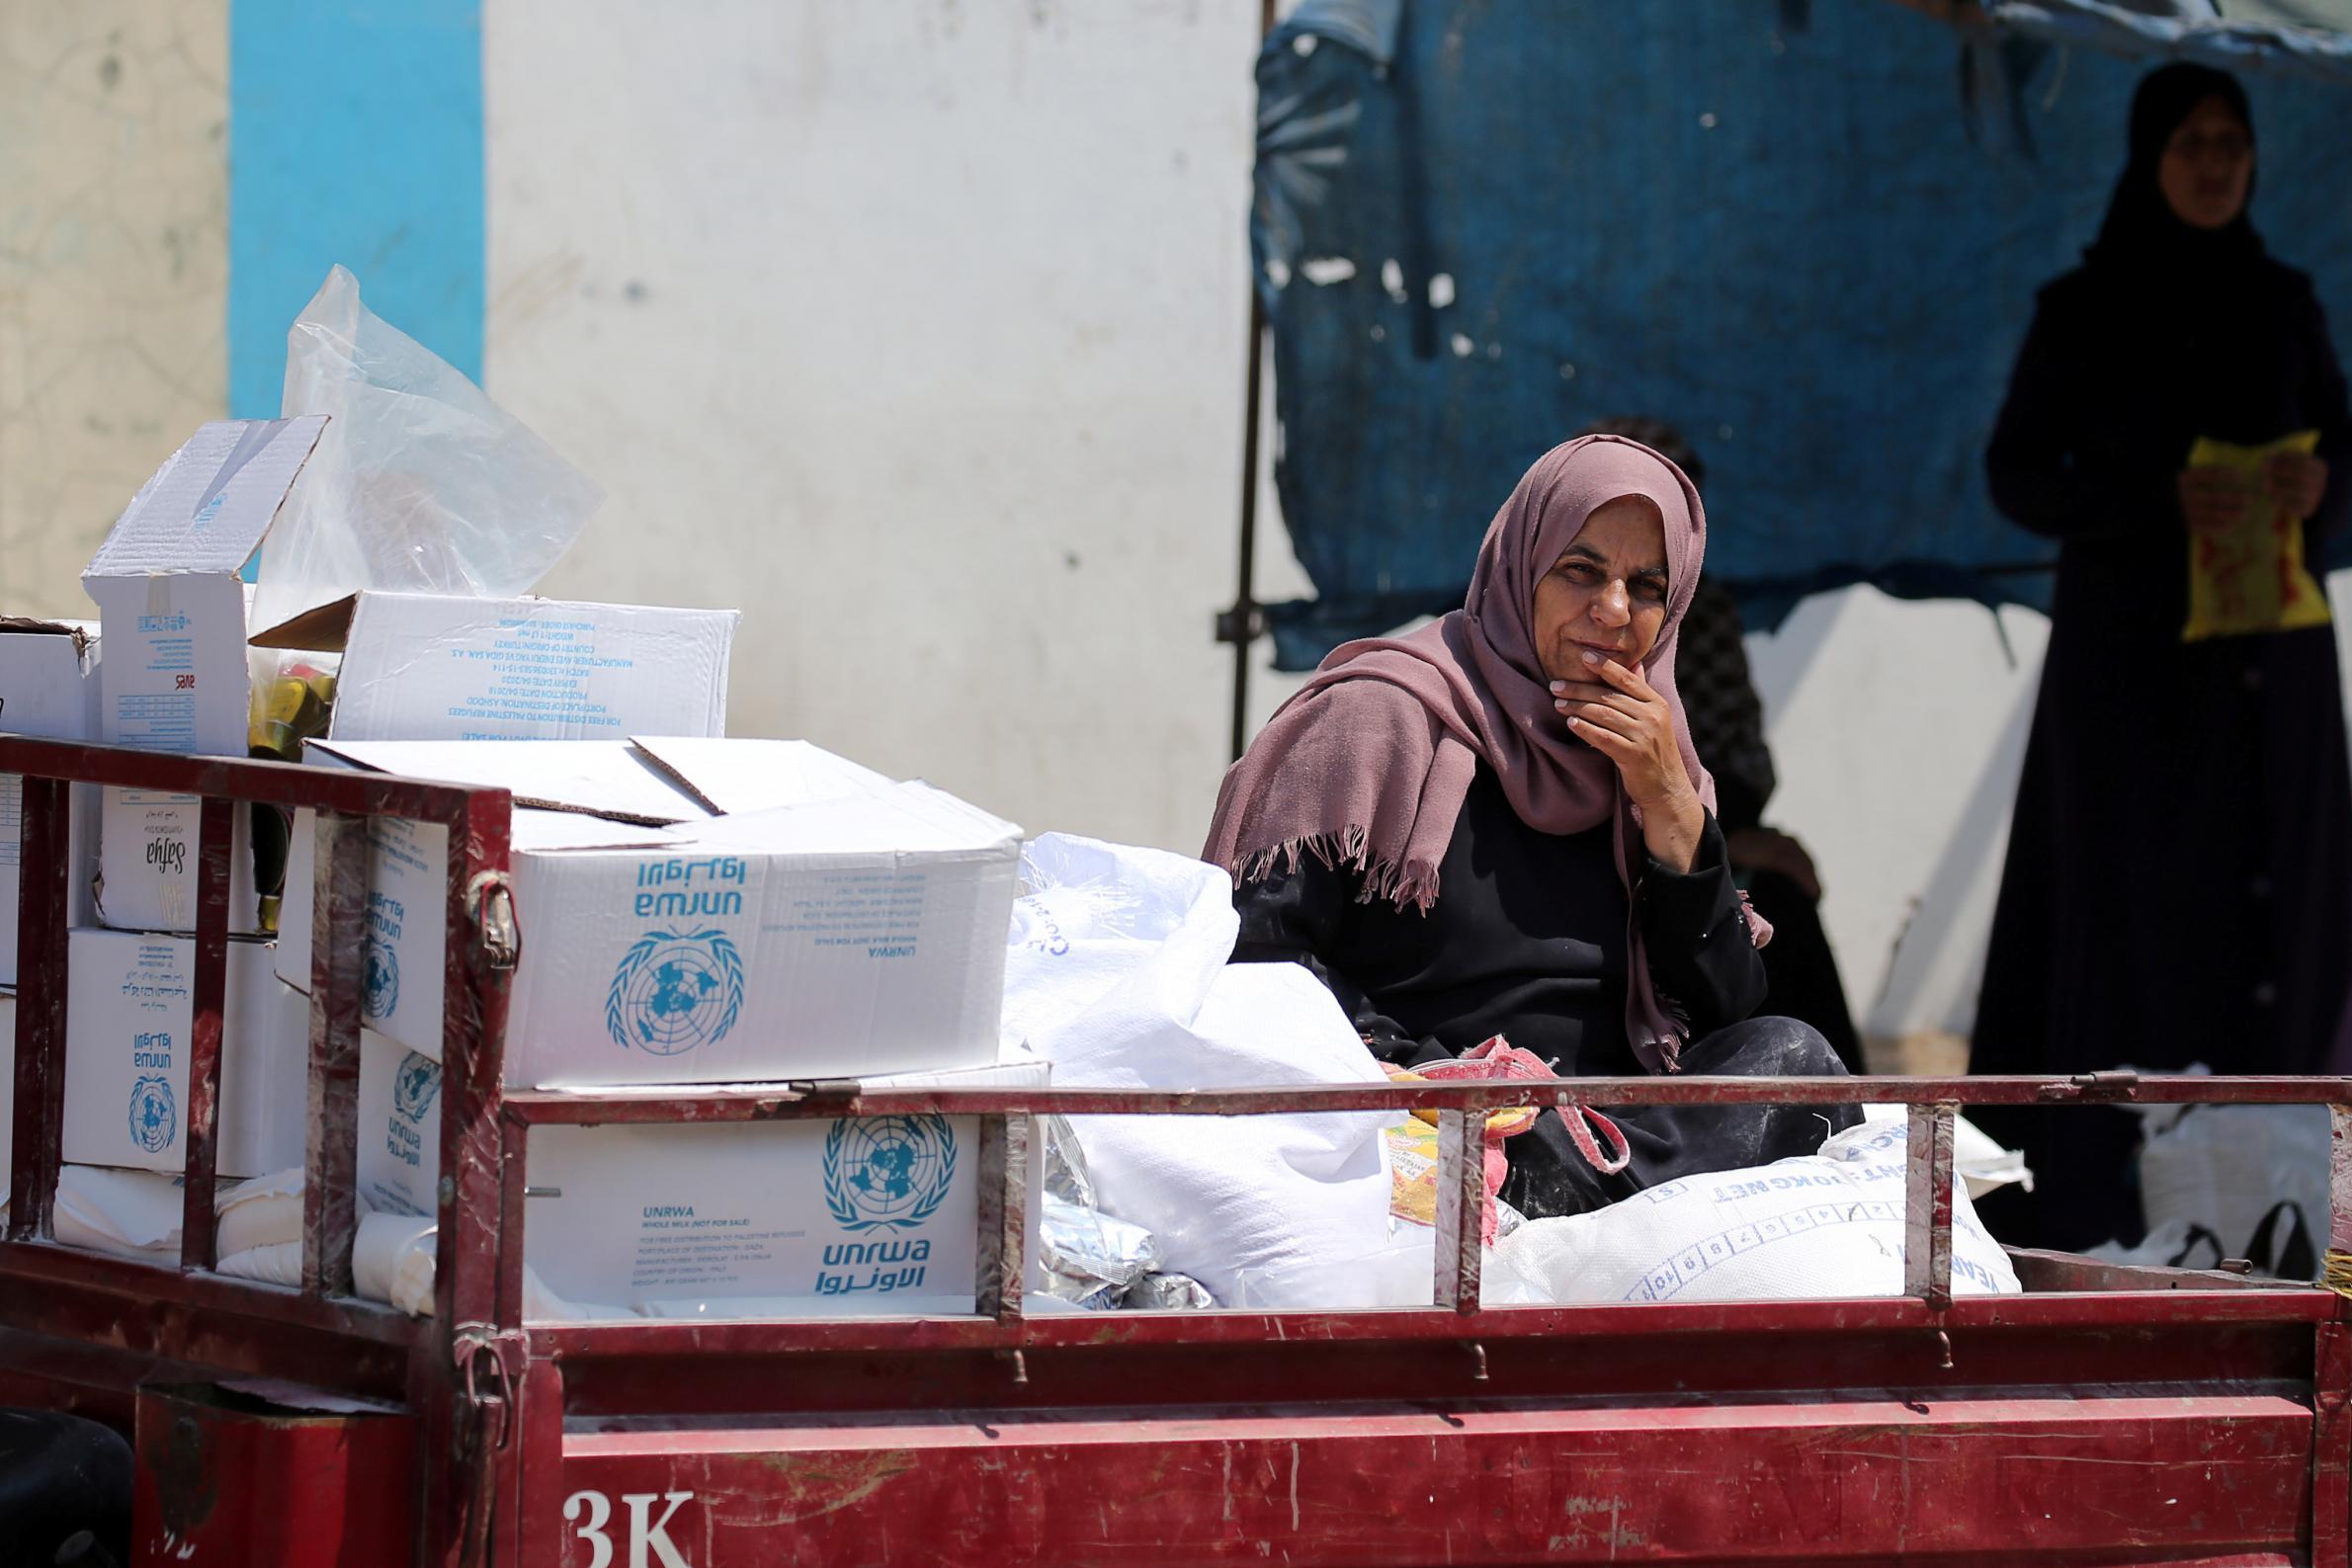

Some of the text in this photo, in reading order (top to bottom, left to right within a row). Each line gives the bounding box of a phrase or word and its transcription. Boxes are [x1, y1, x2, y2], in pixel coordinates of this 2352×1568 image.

[551, 643, 560, 652] OF
[533, 678, 552, 688] DATE:
[520, 689, 541, 699] DATE:
[541, 691, 587, 701] PRODUCTION
[551, 702, 560, 711] OF
[449, 707, 621, 726] FOR FREE DISTRIBUTION TO PALESTINE REFUGEES
[146, 838, 186, 874] Safya
[637, 858, 747, 887] الاونروا
[634, 891, 741, 919] unrwa
[869, 946, 916, 958] UNRWA
[134, 1033, 171, 1051] الاونروا
[134, 1053, 171, 1069] unrwa
[389, 1116, 421, 1150] unrwa
[642, 1205, 695, 1218] UNRWA
[822, 1239, 931, 1266] unrwa
[814, 1267, 925, 1295] الاونروا
[1654, 1271, 1674, 1290] 10
[561, 1488, 694, 1568] 3K
